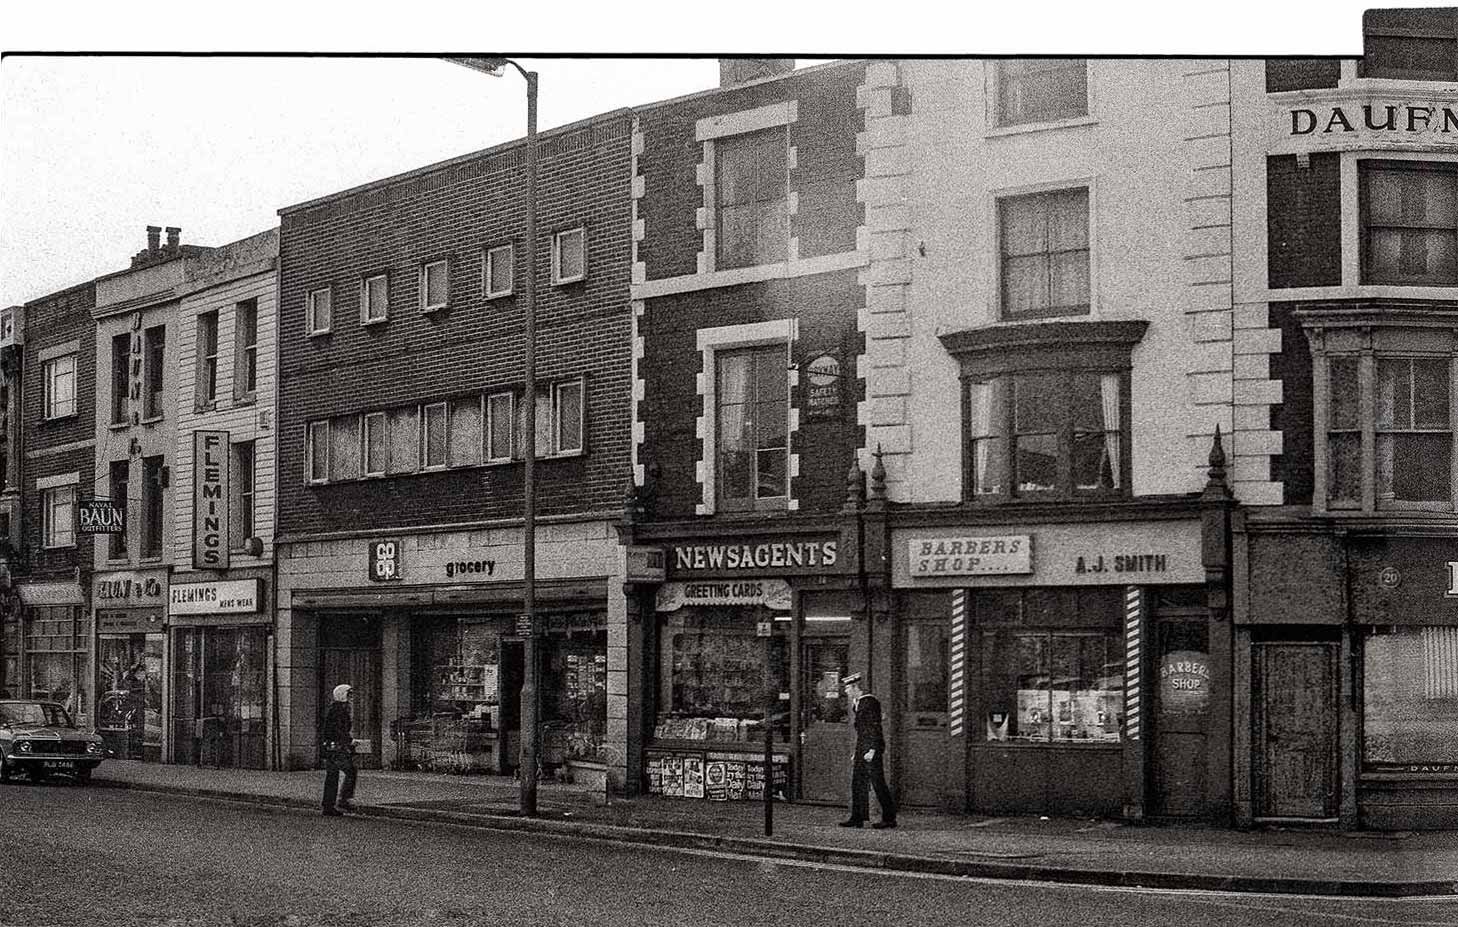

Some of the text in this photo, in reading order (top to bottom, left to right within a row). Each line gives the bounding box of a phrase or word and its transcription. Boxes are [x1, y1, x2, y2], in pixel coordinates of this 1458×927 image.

[89, 501, 113, 509] NAVAL
[202, 435, 222, 565] FLEMINGS
[80, 508, 124, 526] BAUN
[675, 541, 838, 569] NEWSAGENTS
[919, 540, 1022, 557] BARBERS
[446, 560, 496, 578] grocery
[1074, 554, 1167, 574] A.J. SMITH
[1383, 573, 1398, 583] 20
[171, 587, 218, 603] FLEMINGS
[684, 582, 763, 599] GREETING CARDS
[219, 598, 253, 608] MENS WEAR
[1172, 678, 1201, 689] SHOP
[747, 780, 765, 791] Daily
